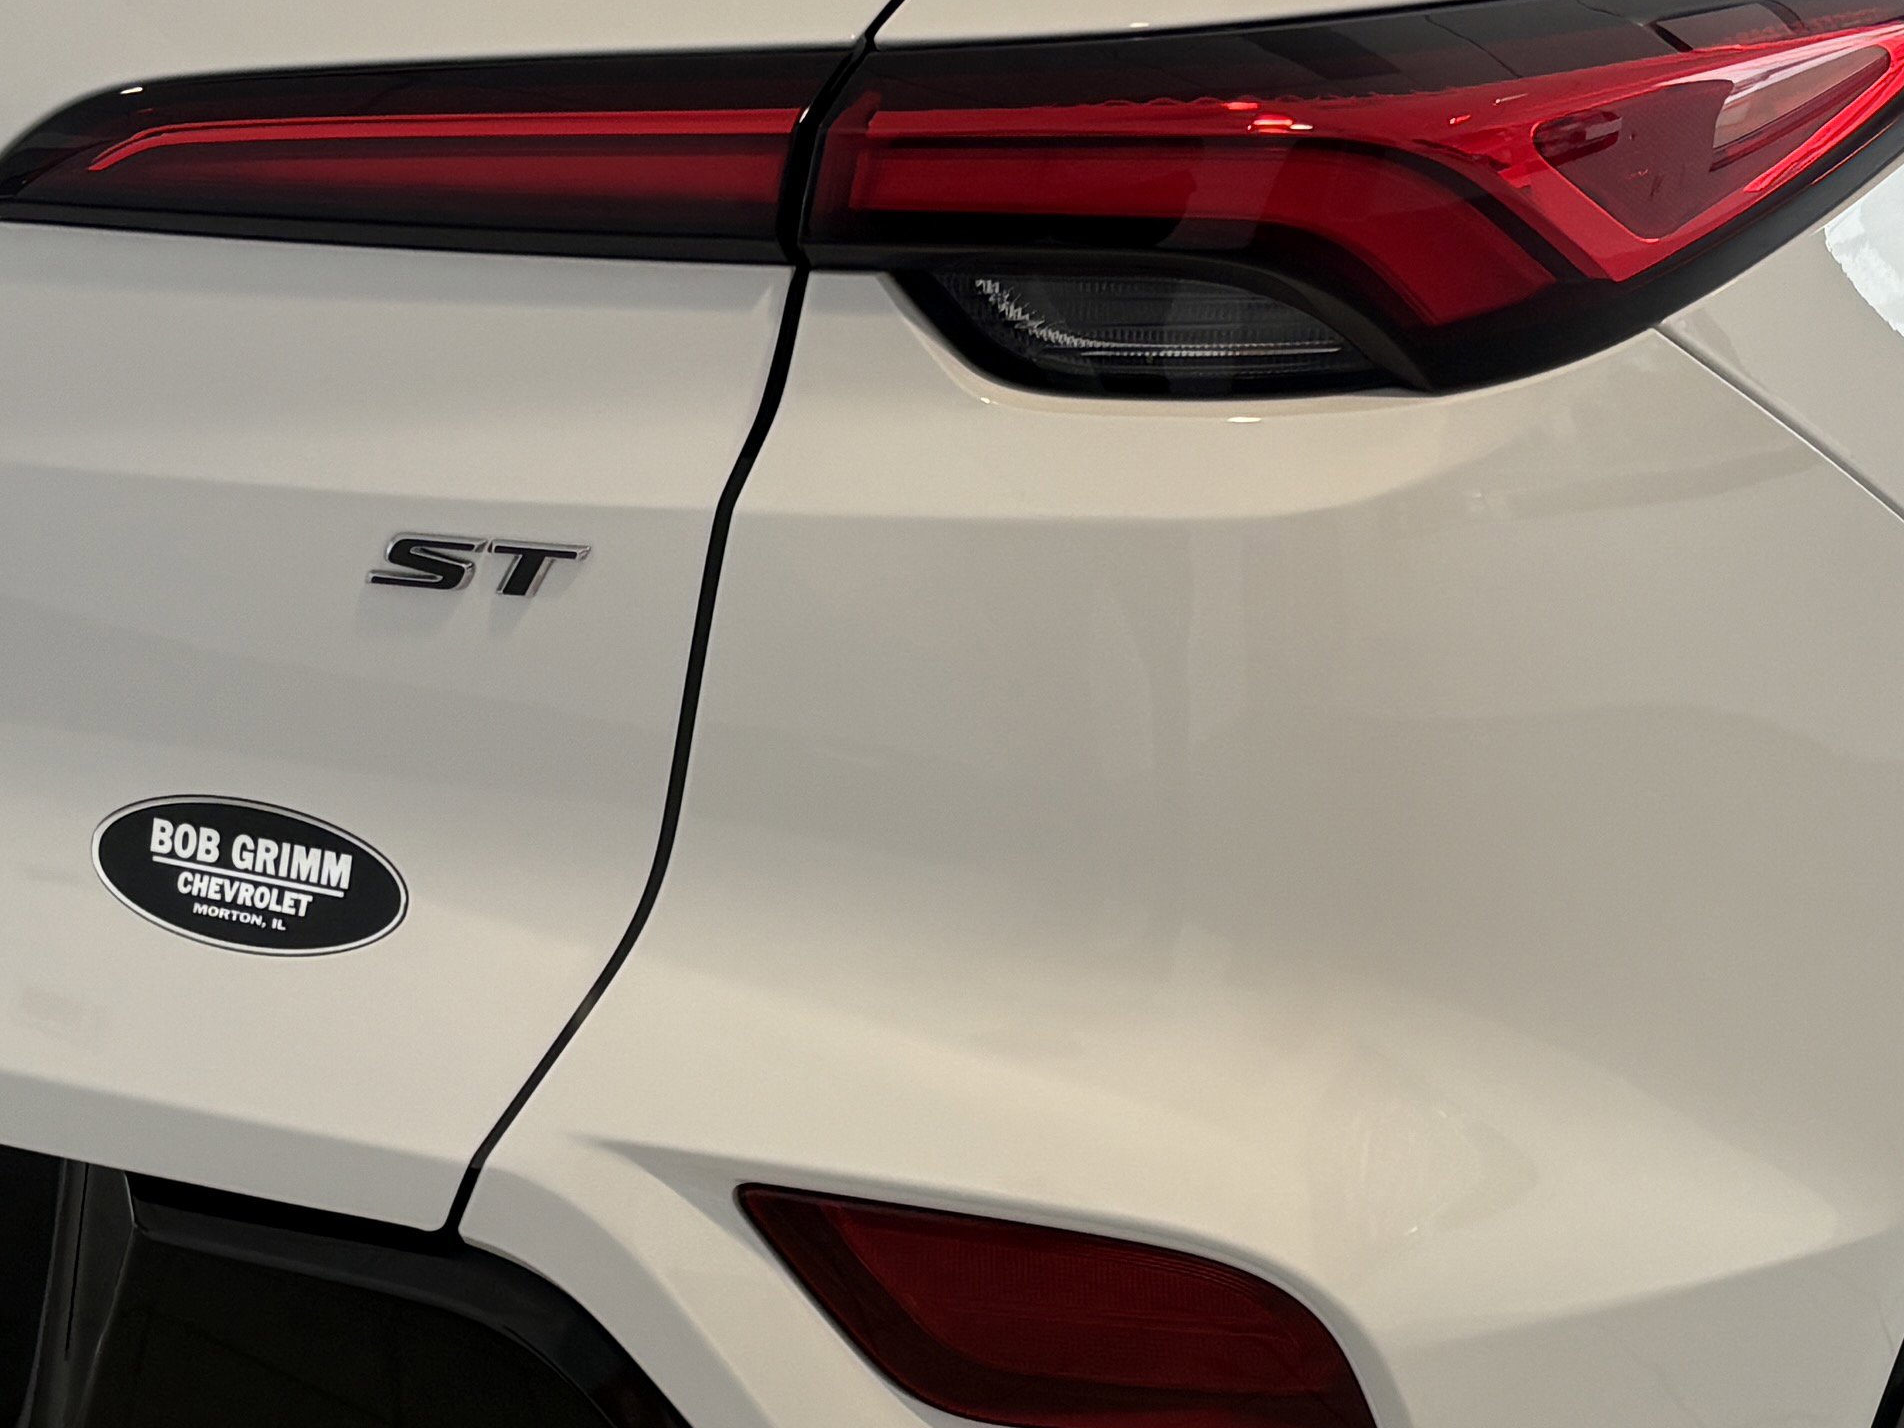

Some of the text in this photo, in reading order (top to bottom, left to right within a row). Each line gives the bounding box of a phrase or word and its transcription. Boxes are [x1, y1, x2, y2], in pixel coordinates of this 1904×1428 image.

[365, 532, 592, 597] ST
[150, 817, 353, 890] BOB GRIMM
[177, 871, 314, 917] CHEVROLET
[192, 902, 287, 931] MORTON, IL
